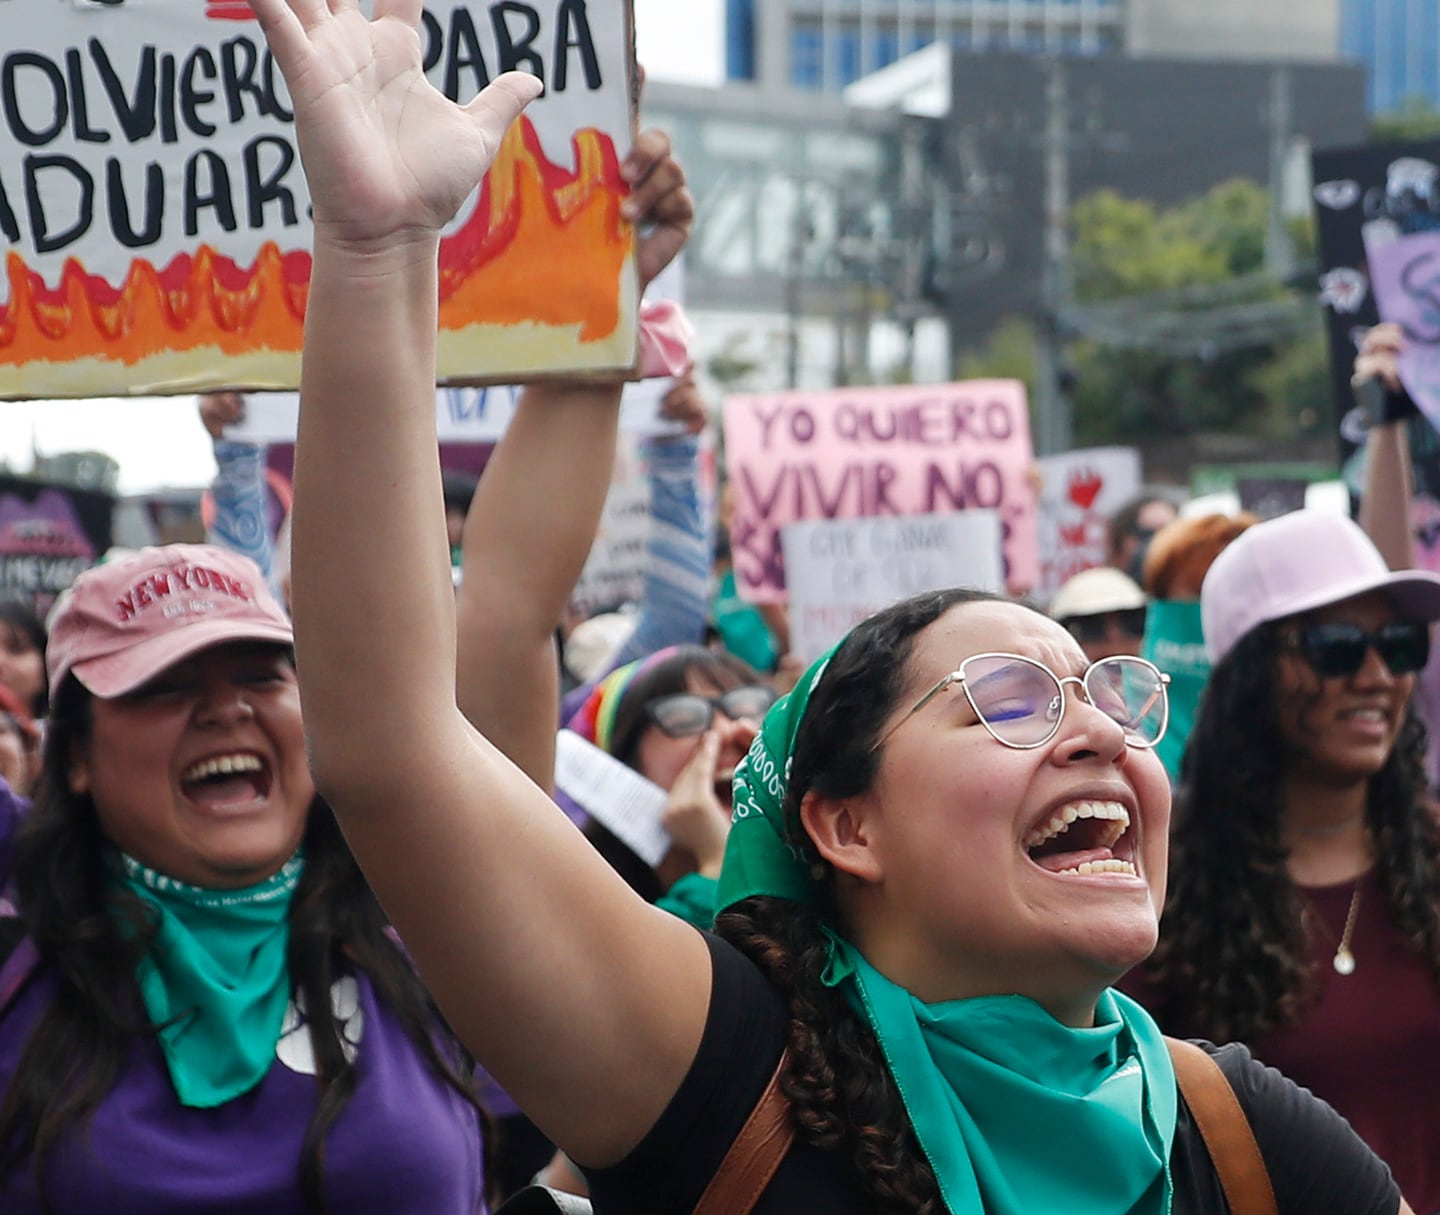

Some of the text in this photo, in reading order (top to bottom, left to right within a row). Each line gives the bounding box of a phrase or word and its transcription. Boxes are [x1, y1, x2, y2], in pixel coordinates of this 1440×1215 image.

[751, 401, 1014, 449] YO QUIERO
[740, 461, 902, 520] VIVIR
[116, 563, 251, 623] NEW YORK
